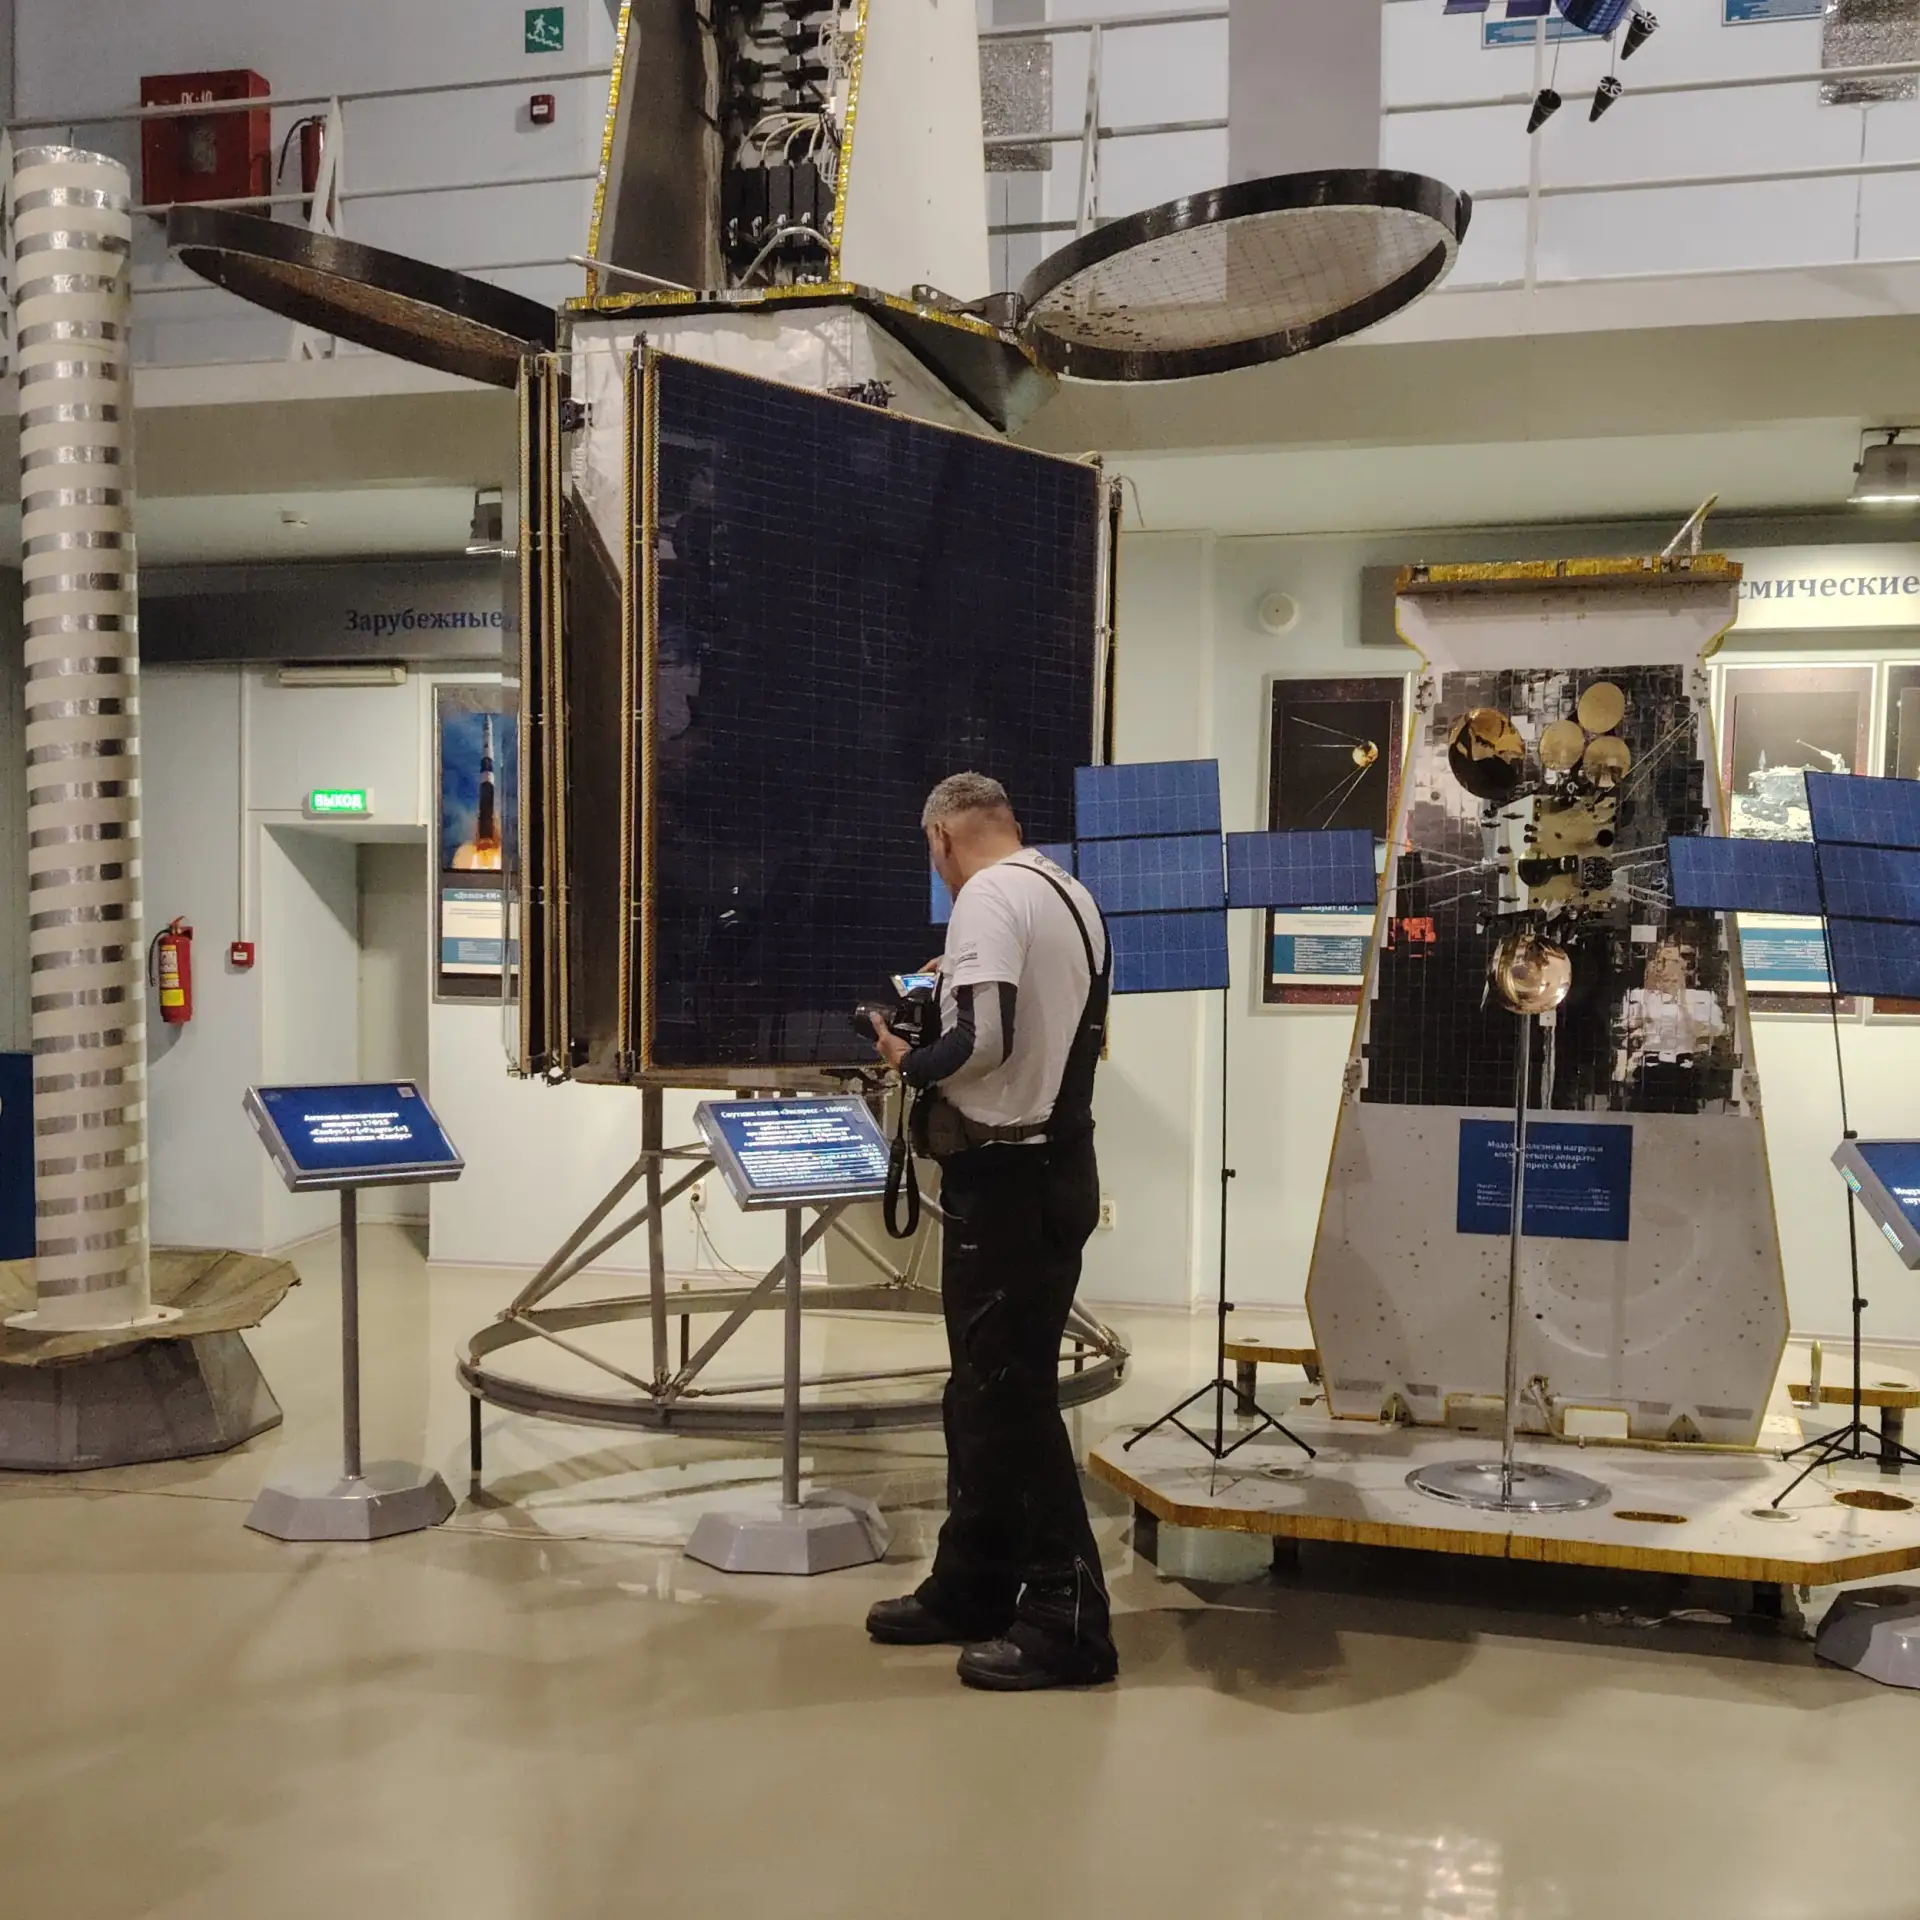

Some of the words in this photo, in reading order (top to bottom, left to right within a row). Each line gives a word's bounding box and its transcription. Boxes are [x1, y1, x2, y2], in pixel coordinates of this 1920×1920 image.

[346, 608, 503, 636] Зарубежные
[314, 793, 363, 810] ВЫХОД
[720, 1109, 756, 1119] Спутник
[756, 1109, 779, 1117] связи
[1487, 1140, 1516, 1150] Модул
